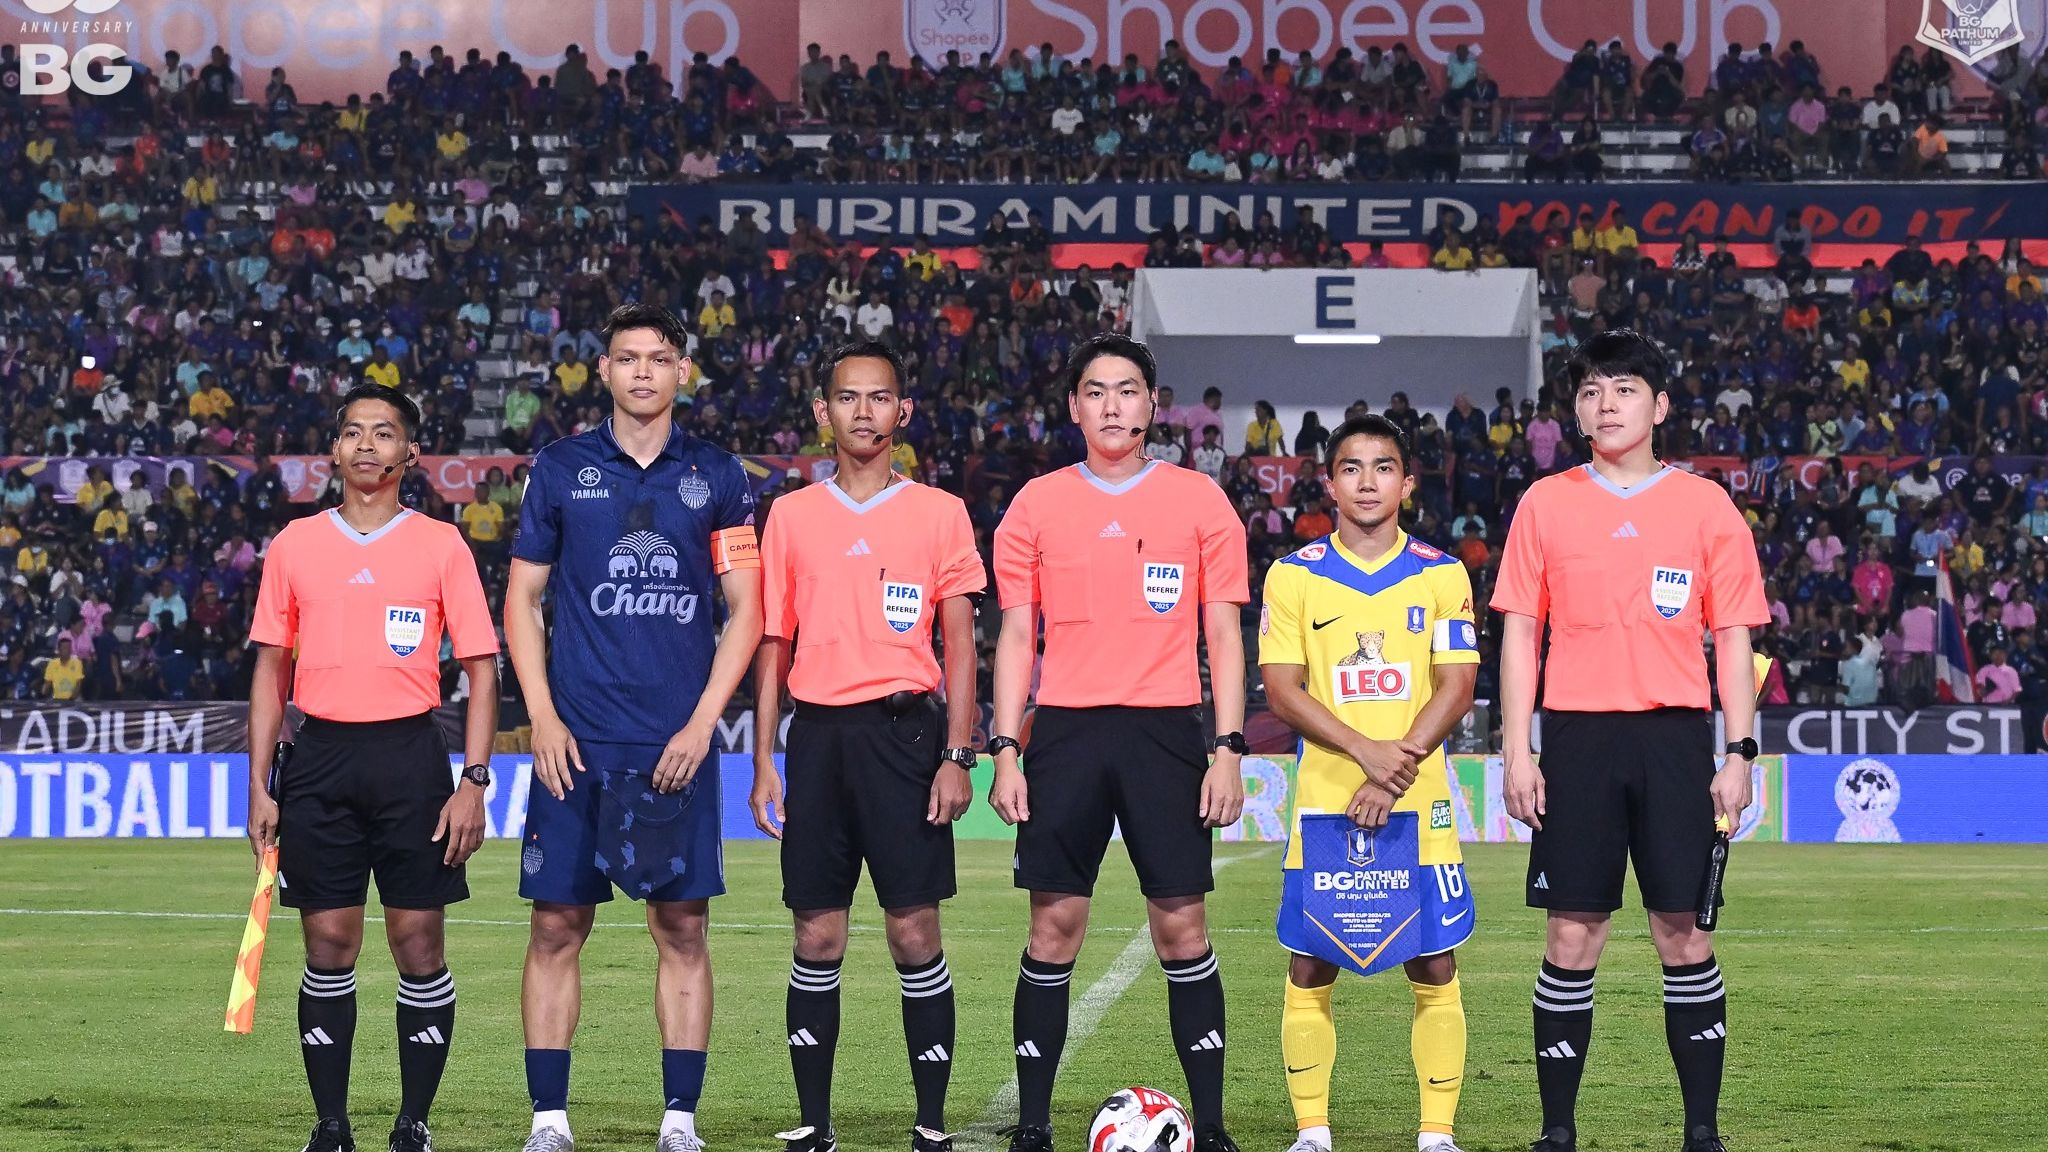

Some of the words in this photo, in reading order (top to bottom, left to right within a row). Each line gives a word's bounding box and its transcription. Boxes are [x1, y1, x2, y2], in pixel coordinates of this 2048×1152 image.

[920, 28, 991, 47] Shopee
[719, 196, 1118, 236] BURIRAM
[1135, 194, 1479, 236] UNITED
[1641, 200, 1777, 237] CAN
[1801, 204, 1883, 238] DO
[1316, 276, 1357, 328] E
[571, 488, 610, 500] YAMAHA
[1147, 566, 1180, 580] FIFA
[1656, 570, 1687, 585] FIFA
[887, 585, 919, 600] FIFA
[1146, 586, 1179, 595] REFEREE
[591, 582, 699, 625] Chang
[886, 605, 919, 615] REFEREE
[1155, 602, 1170, 610] 2025
[1661, 607, 1676, 615] 2025
[389, 609, 421, 623] FIFA
[1340, 668, 1405, 699] LEO
[1787, 710, 1920, 755] CITY
[1314, 871, 1355, 891] BG
[1354, 870, 1409, 881] PATHUM
[1354, 879, 1410, 890] UNITED
[1433, 863, 1464, 903] 18
